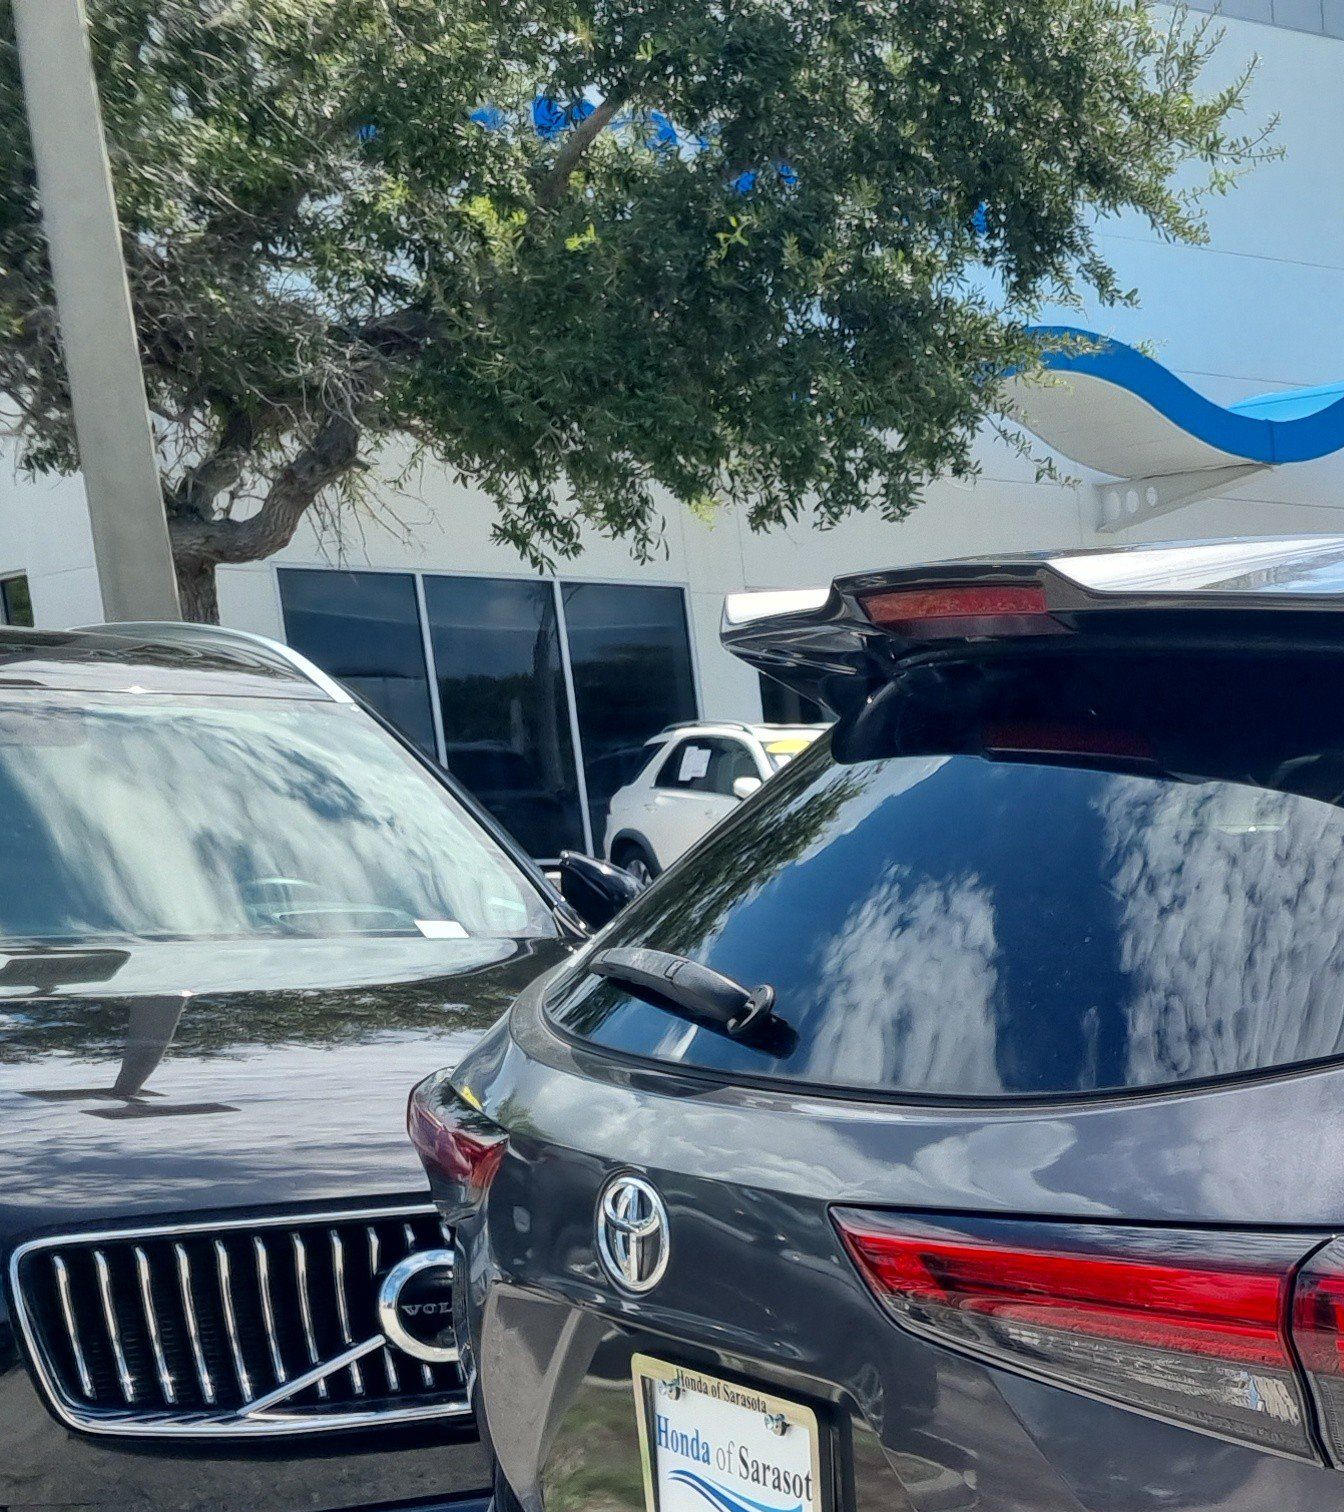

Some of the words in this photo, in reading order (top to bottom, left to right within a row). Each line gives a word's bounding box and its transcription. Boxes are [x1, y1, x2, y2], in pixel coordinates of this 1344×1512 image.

[676, 1368, 709, 1396] Honda
[711, 1381, 721, 1399] of
[723, 1383, 767, 1414] Sarasota
[657, 1414, 711, 1466] Honda
[716, 1440, 736, 1474] of
[738, 1445, 813, 1501] Sarasot
